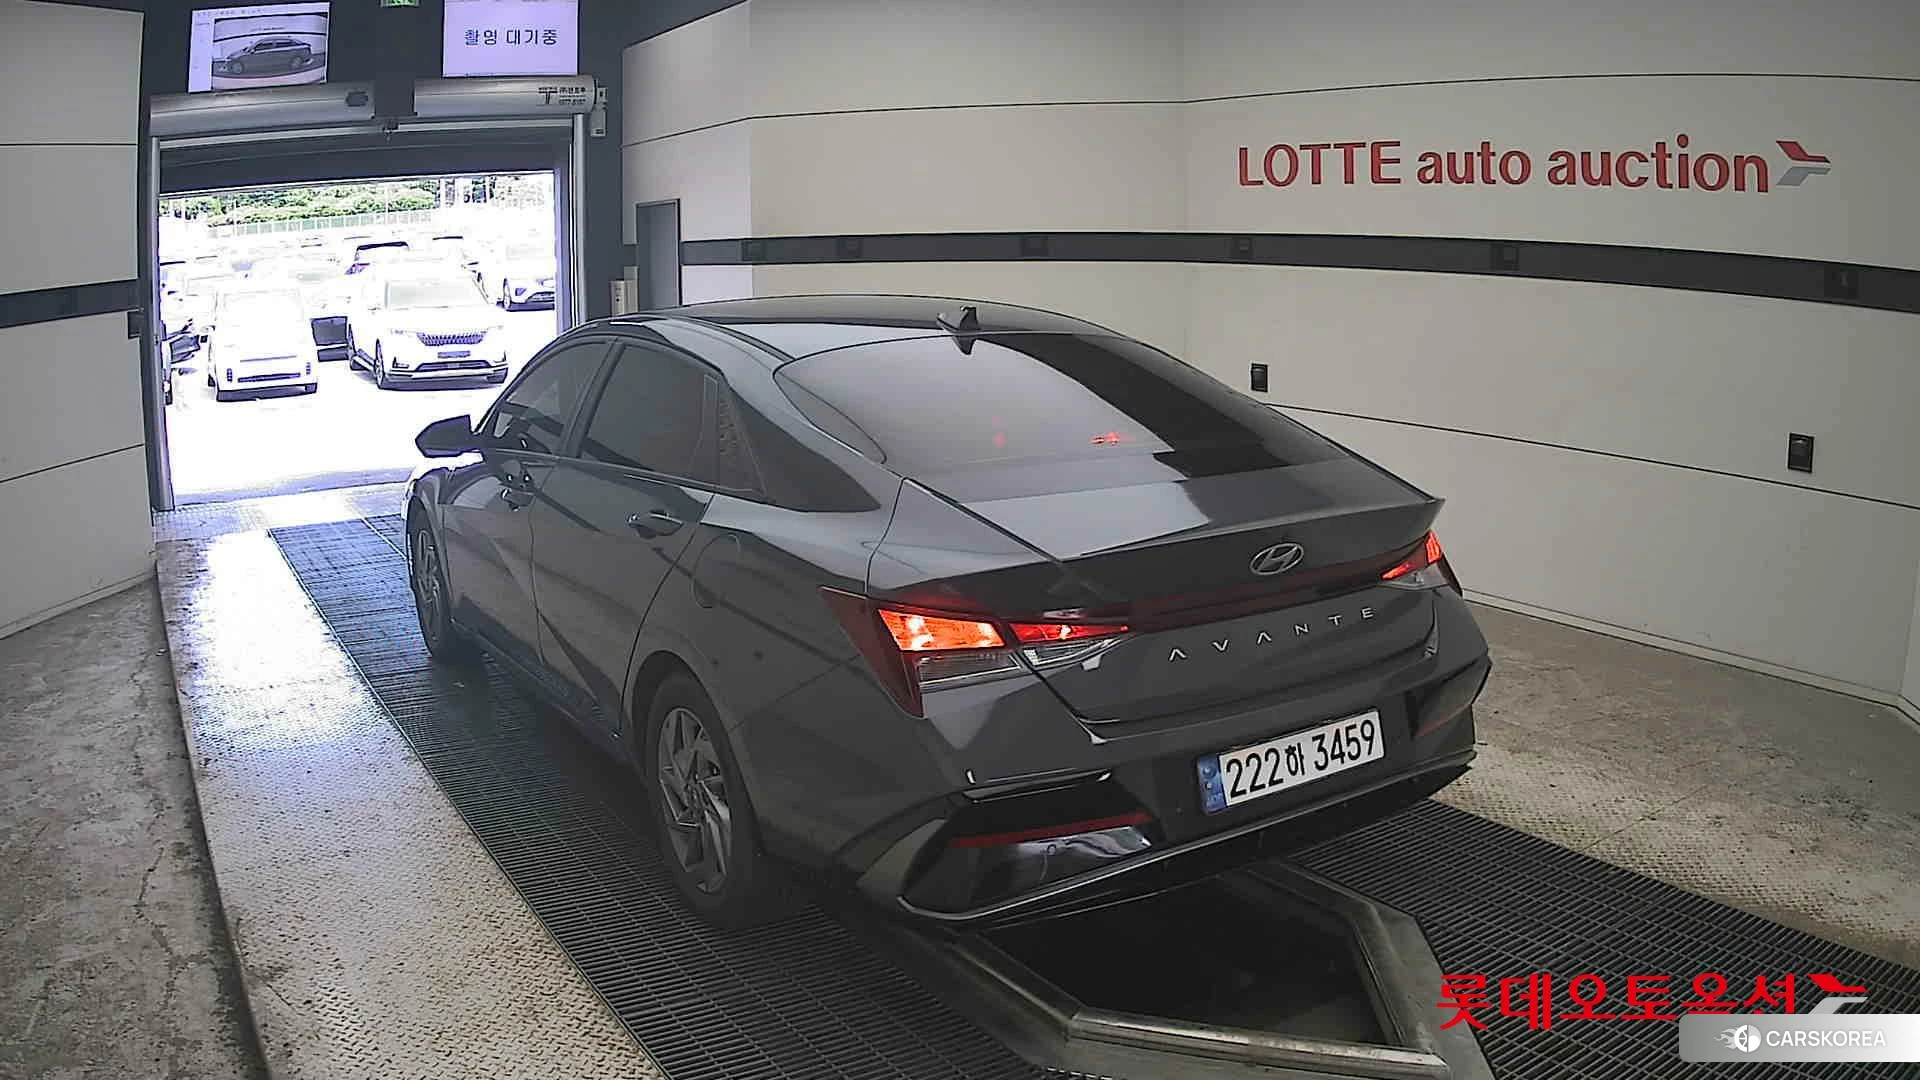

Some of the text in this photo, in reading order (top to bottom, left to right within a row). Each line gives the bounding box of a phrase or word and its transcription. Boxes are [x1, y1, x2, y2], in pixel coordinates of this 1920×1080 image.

[506, 29, 558, 46] 대기중
[1238, 134, 1769, 193] LOTTE auto auction
[1168, 605, 1375, 662] AVANTE
[1225, 718, 1376, 799] 222하 3459
